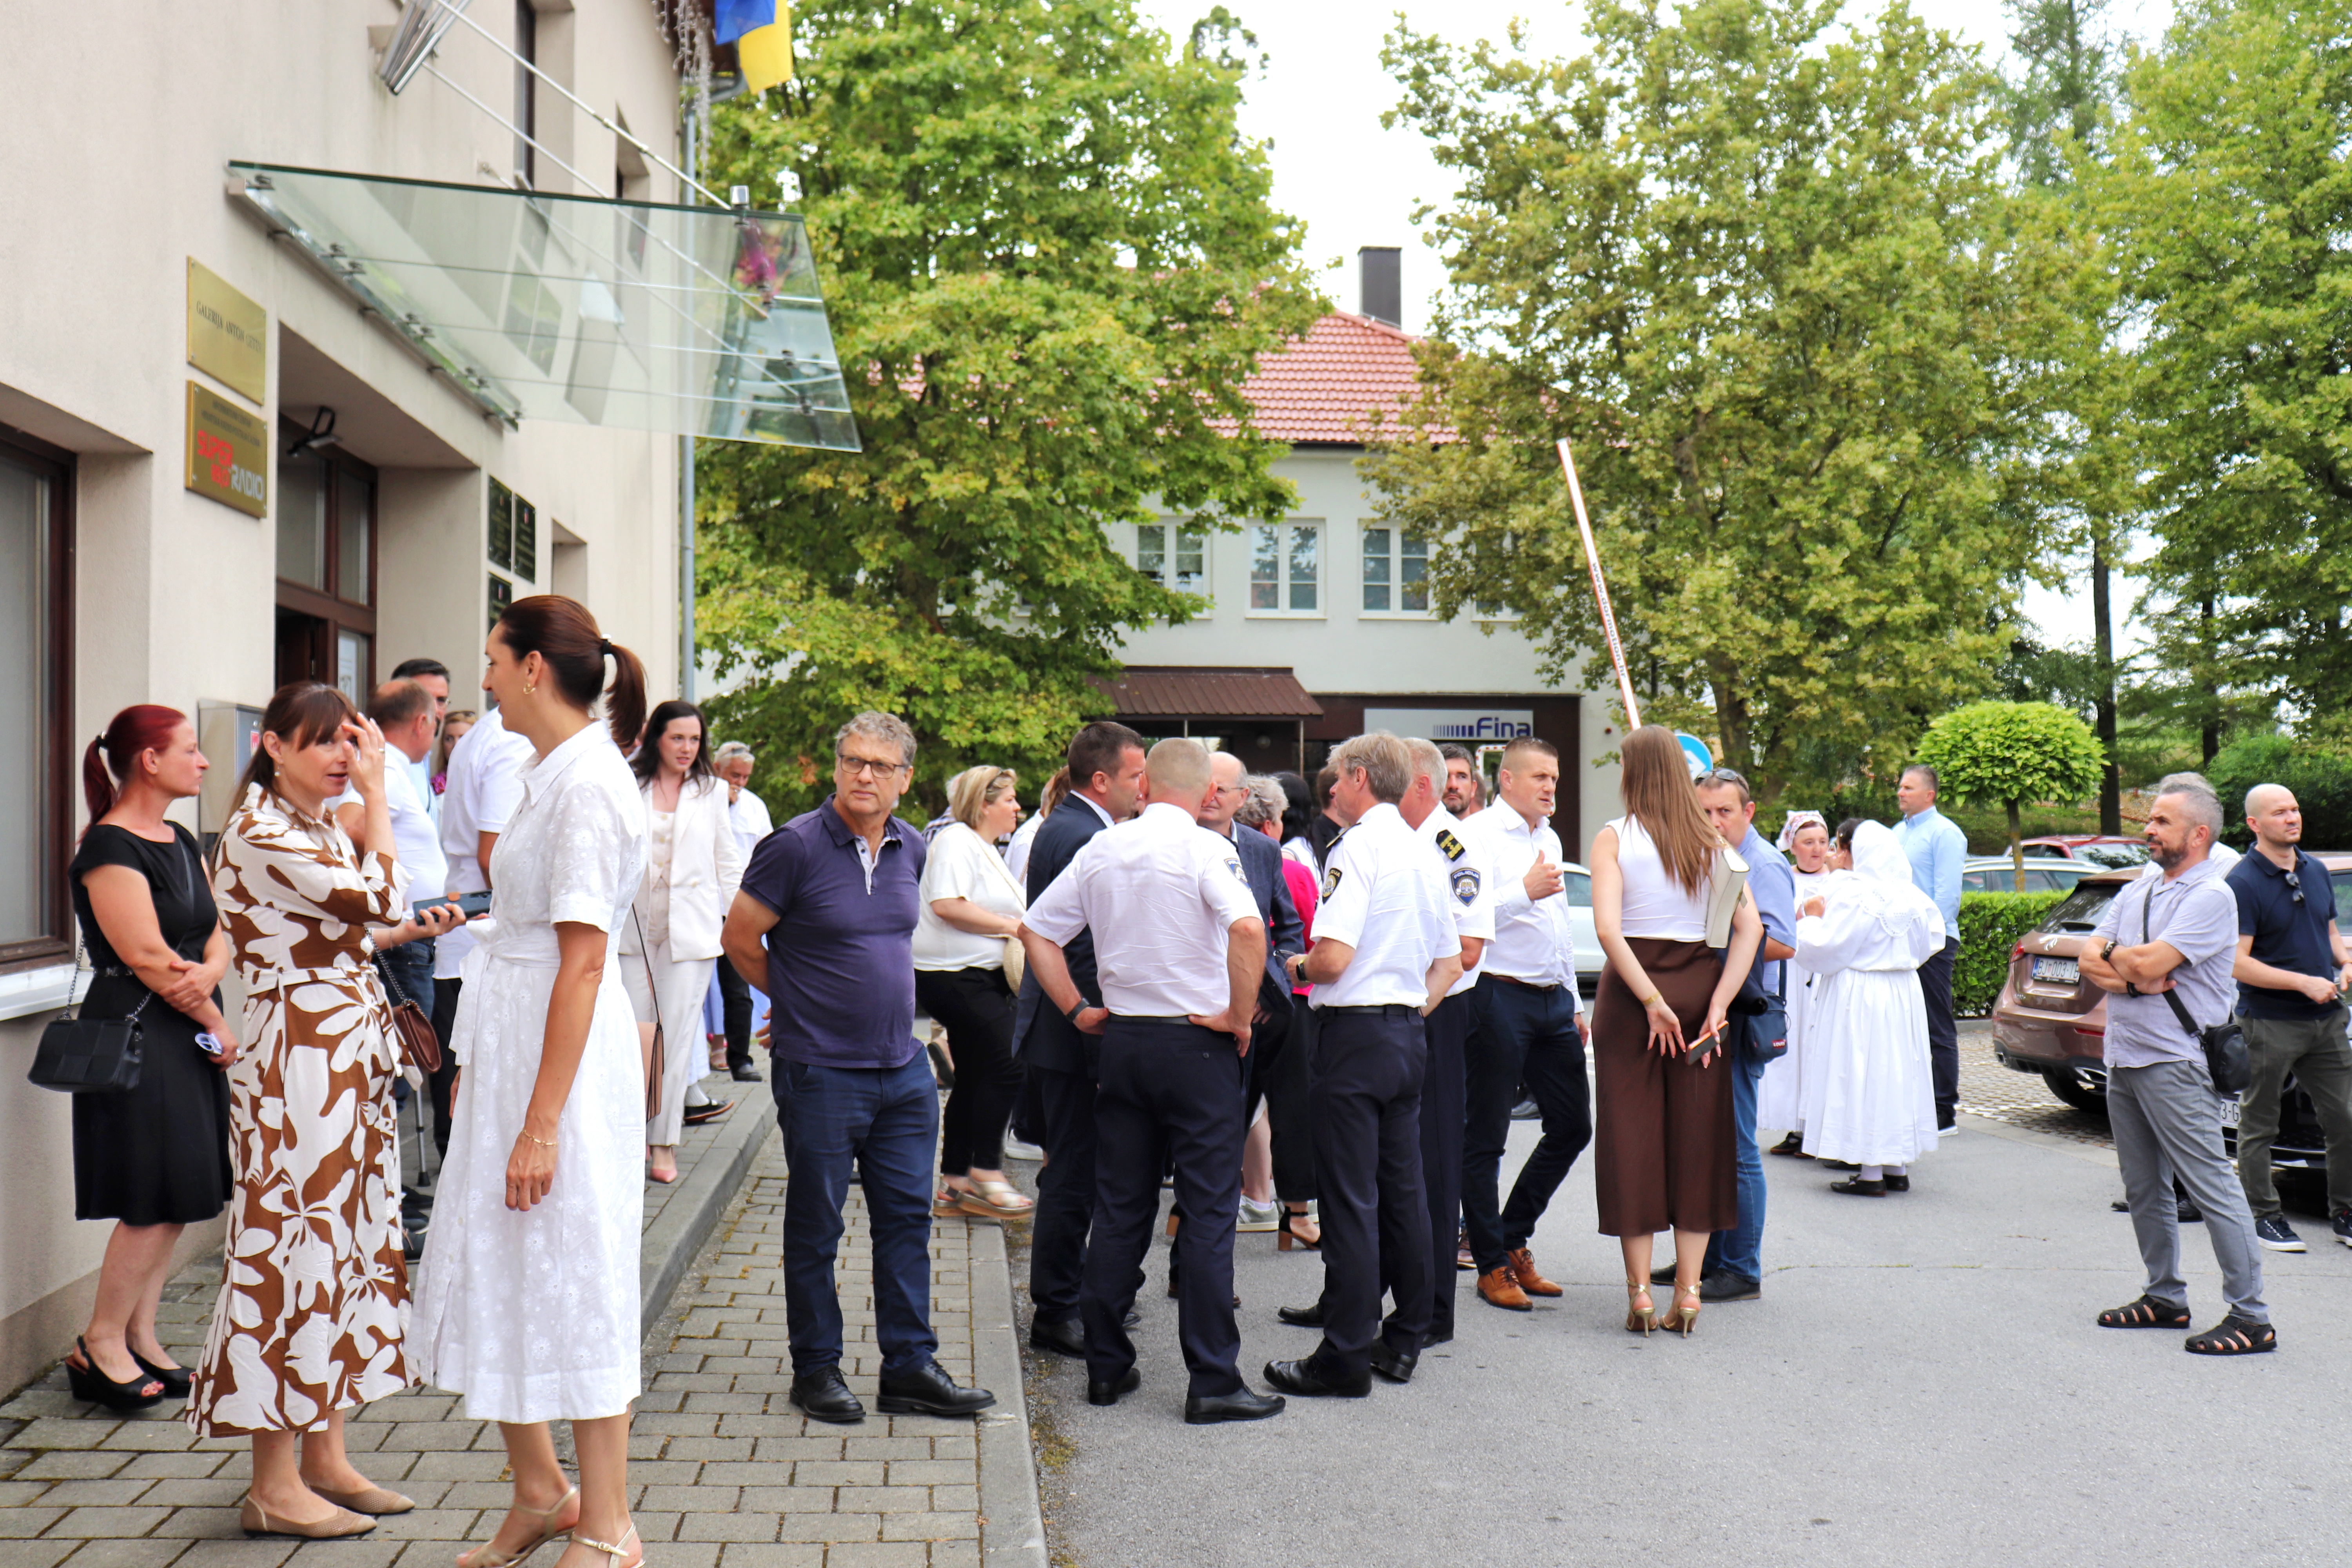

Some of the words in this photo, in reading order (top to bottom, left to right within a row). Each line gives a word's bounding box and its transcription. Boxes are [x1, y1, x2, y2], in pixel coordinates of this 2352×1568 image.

[197, 301, 223, 329] GALERIJA
[226, 321, 244, 342] ANTON
[197, 430, 232, 468] SUPER
[231, 464, 263, 501] RADIO
[1592, 562, 1626, 678] www.dormotion.hr
[1477, 717, 1531, 737] Fina
[1454, 871, 1479, 879] POLICIJA
[2038, 960, 2048, 975] BJ
